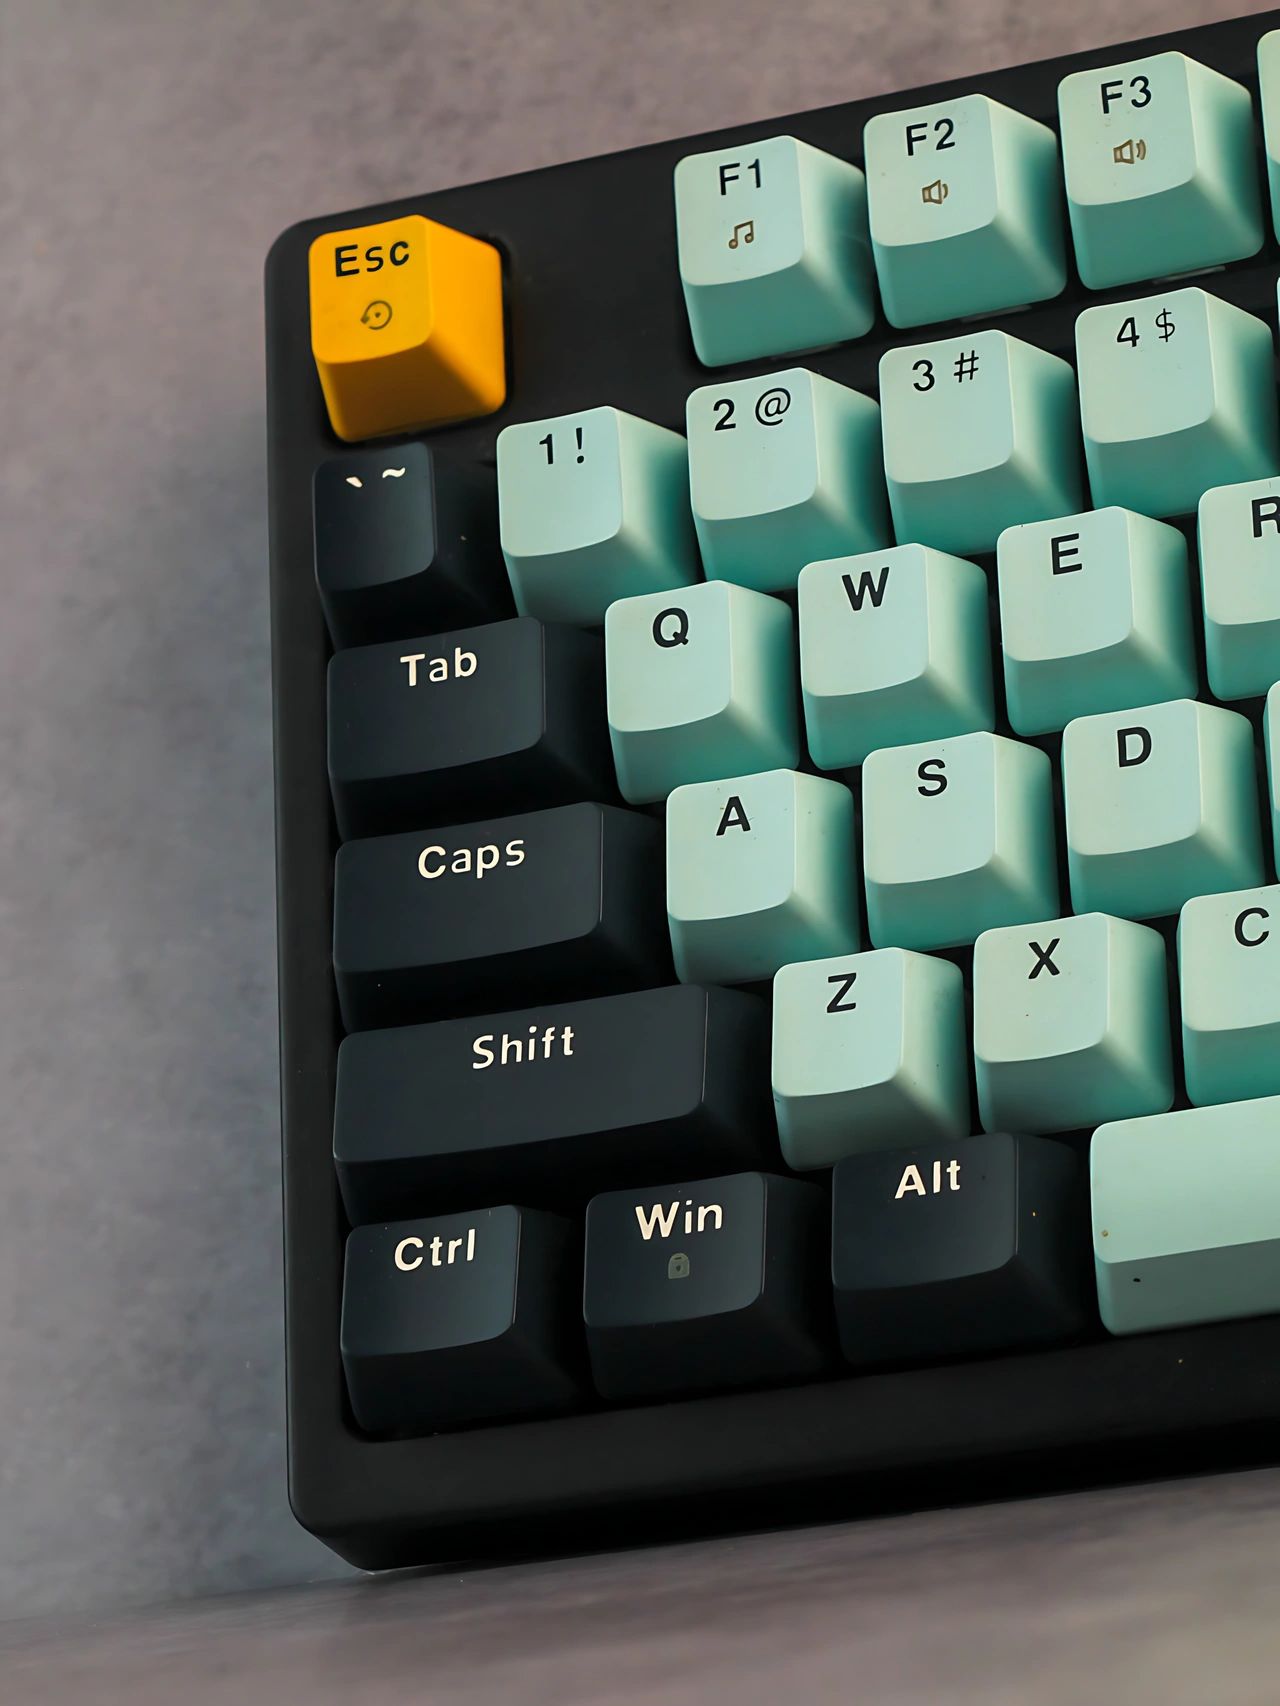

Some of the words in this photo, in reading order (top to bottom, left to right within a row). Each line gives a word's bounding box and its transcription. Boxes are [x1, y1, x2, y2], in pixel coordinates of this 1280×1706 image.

[1100, 75, 1152, 115] F3
[905, 118, 956, 157] F2
[719, 158, 761, 196] F1
[334, 240, 410, 278] Esc
[1116, 316, 1140, 348] 4
[1155, 307, 1176, 343] $
[912, 359, 936, 392] 3
[953, 349, 980, 384] #
[713, 398, 737, 432] 2
[754, 387, 792, 427] @
[538, 433, 554, 465] 1
[575, 427, 585, 464] !
[1251, 495, 1280, 538] R
[1050, 532, 1083, 576] E
[841, 566, 890, 612] W
[652, 607, 689, 649] Q
[399, 647, 477, 687] Tab
[1116, 726, 1152, 768] D
[917, 758, 948, 797] S
[715, 795, 751, 837] A
[418, 839, 525, 879] Caps
[1234, 907, 1270, 947] C
[1028, 937, 1061, 980] X
[826, 972, 857, 1014] Z
[472, 1025, 575, 1070] Shift
[894, 1159, 961, 1199] Alt
[635, 1201, 723, 1241] Win
[394, 1228, 476, 1271] Ctrl
